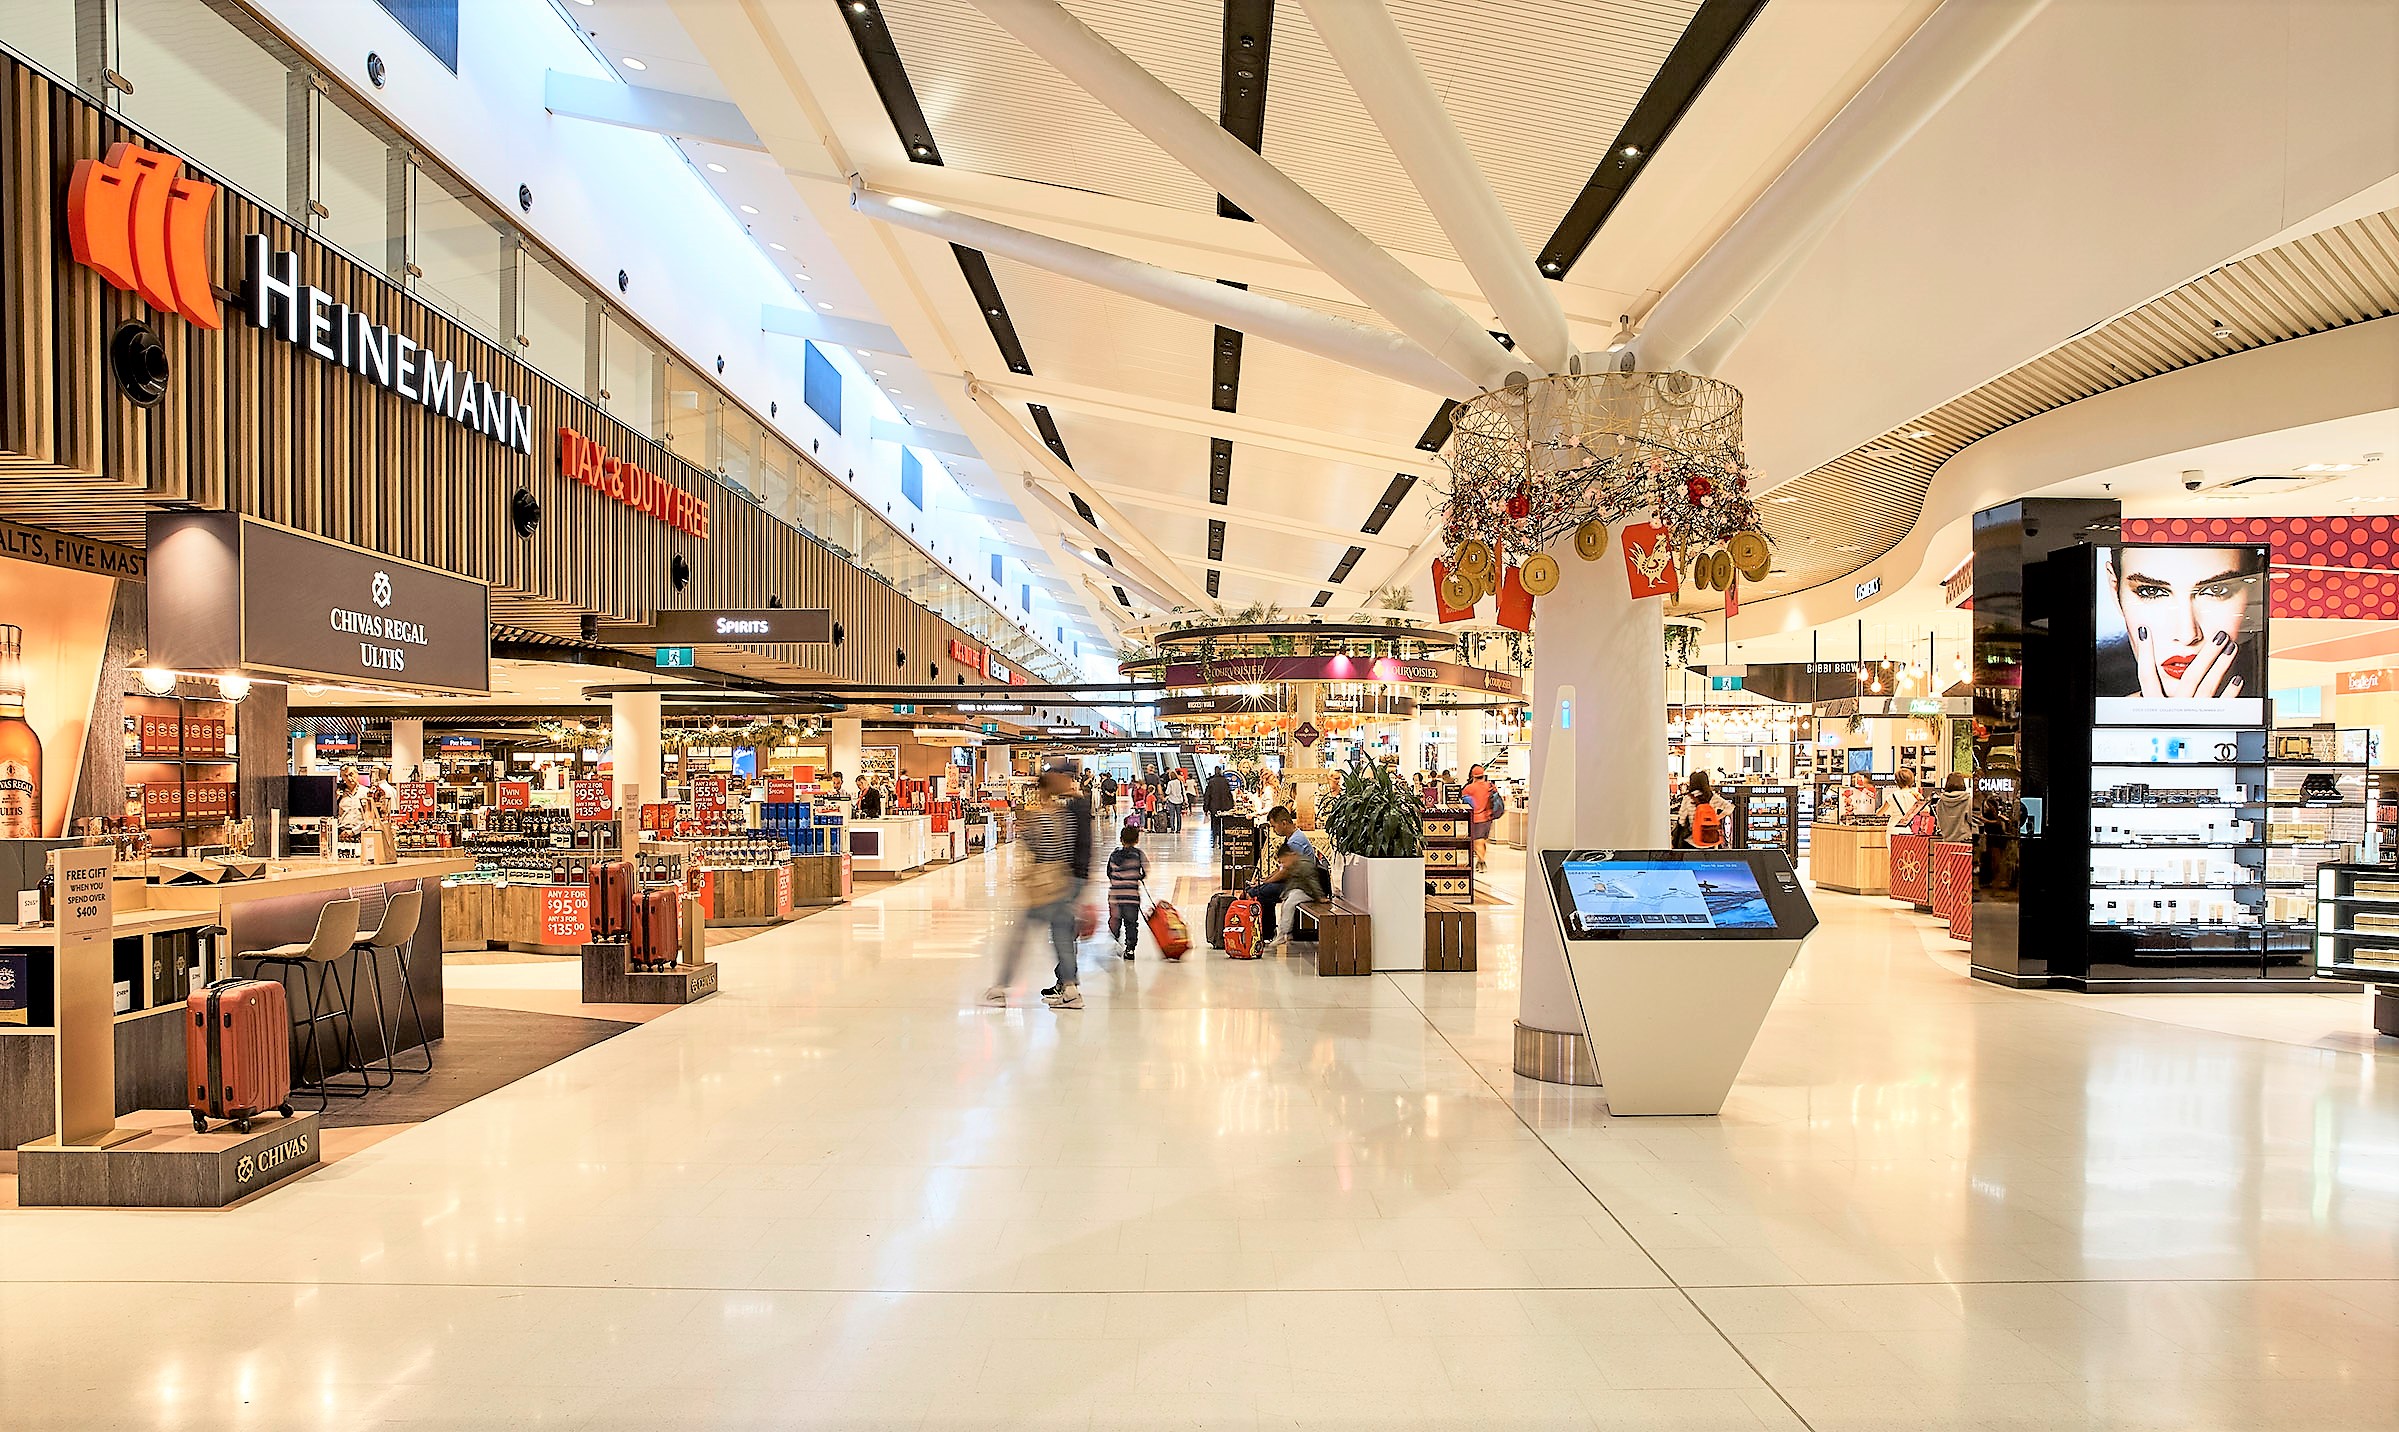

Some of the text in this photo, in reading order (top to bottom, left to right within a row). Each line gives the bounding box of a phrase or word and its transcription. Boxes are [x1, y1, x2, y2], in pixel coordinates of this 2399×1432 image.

[247, 233, 532, 456] HEINEMANN
[561, 427, 709, 540] TAX & DUTY FREE
[55, 539, 95, 567] FIVE
[330, 607, 429, 645] CHIVAS REGAL
[716, 617, 768, 634] SPIRITS
[360, 642, 405, 672] ULTIS
[1806, 663, 1832, 674] BOBBI
[2349, 674, 2379, 690] benefit
[12, 780, 33, 795] REGAL
[501, 786, 520, 796] TWIN
[1978, 778, 2014, 791] CHANEL
[400, 789, 427, 800] $55.00
[575, 789, 605, 801] $95.00
[695, 787, 719, 797] $55.00
[501, 797, 523, 806] PACKS
[0, 807, 23, 816] ULTIS
[575, 807, 601, 817] $135.00
[66, 867, 108, 880] FREE GIFT
[70, 882, 104, 892] WHEN YOU
[67, 893, 106, 905] SPEND OVER
[547, 890, 587, 899] ANY 2 FOR
[76, 905, 98, 918] $400
[547, 899, 589, 915] $95.00
[547, 915, 578, 923] ANY 3 FOR
[547, 923, 585, 936] $135.00
[256, 1134, 309, 1172] CHIVAS
